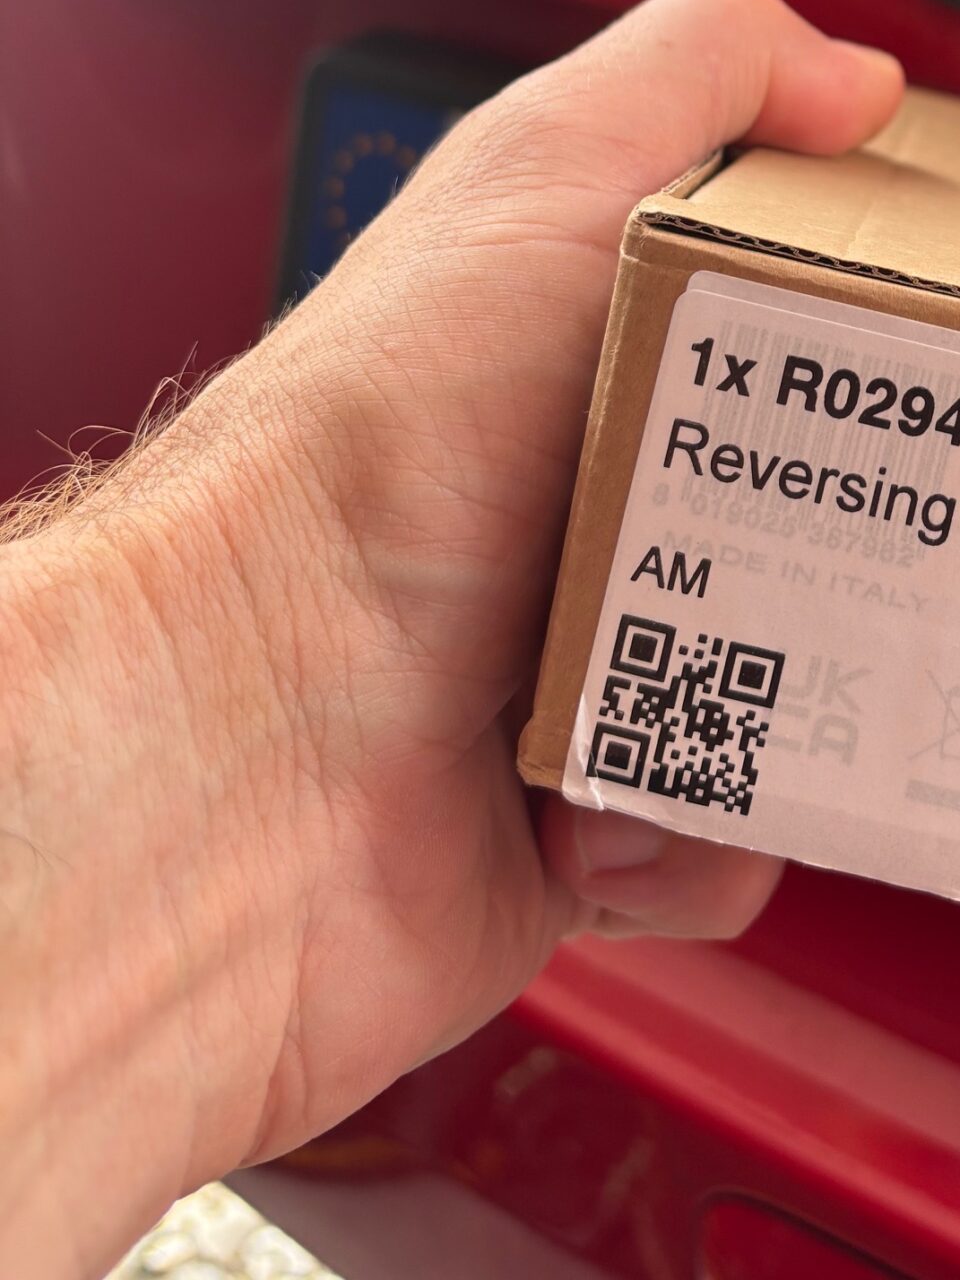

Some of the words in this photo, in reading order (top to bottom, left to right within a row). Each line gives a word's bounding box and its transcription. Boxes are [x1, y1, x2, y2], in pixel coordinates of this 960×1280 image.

[691, 337, 758, 398] 1x
[662, 417, 957, 547] Reversing
[629, 546, 713, 599] AM
